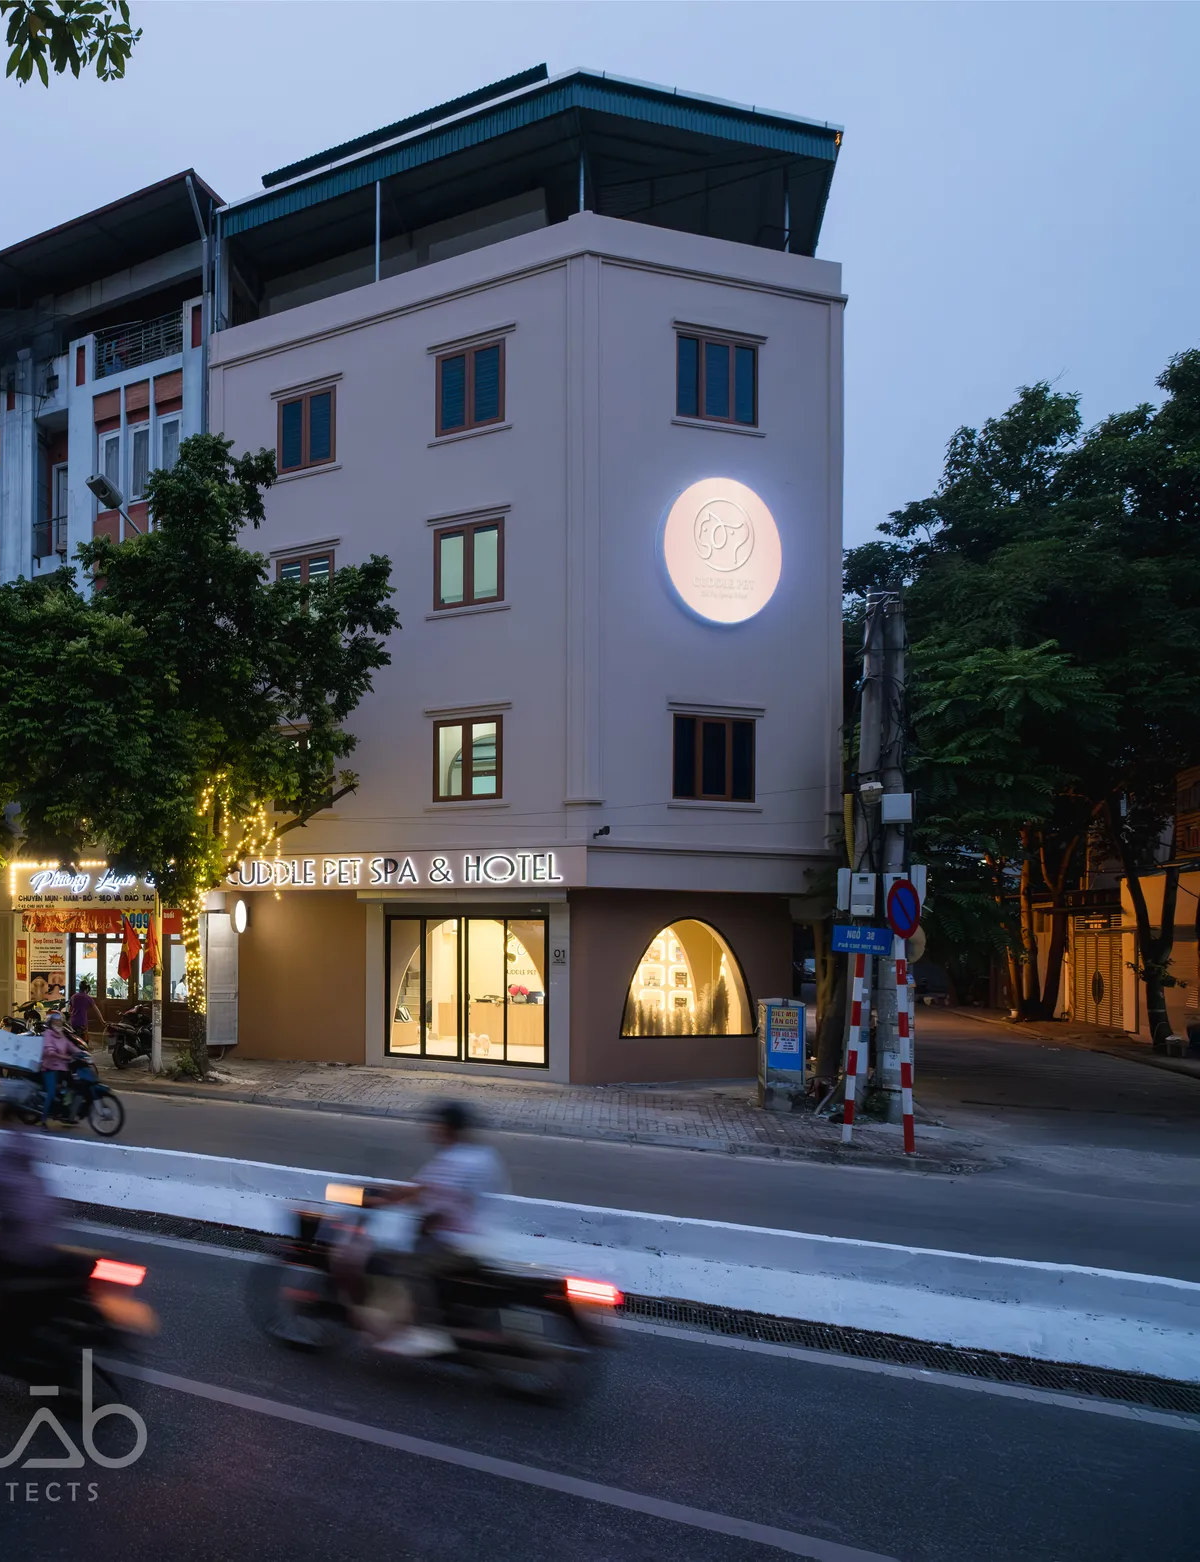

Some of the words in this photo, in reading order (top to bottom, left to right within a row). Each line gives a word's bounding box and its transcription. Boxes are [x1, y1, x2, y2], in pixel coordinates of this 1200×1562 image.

[323, 858, 362, 884] PET
[370, 857, 418, 883] SPA
[429, 857, 452, 883] &
[464, 853, 563, 883] HOTEL
[553, 949, 566, 959] 01
